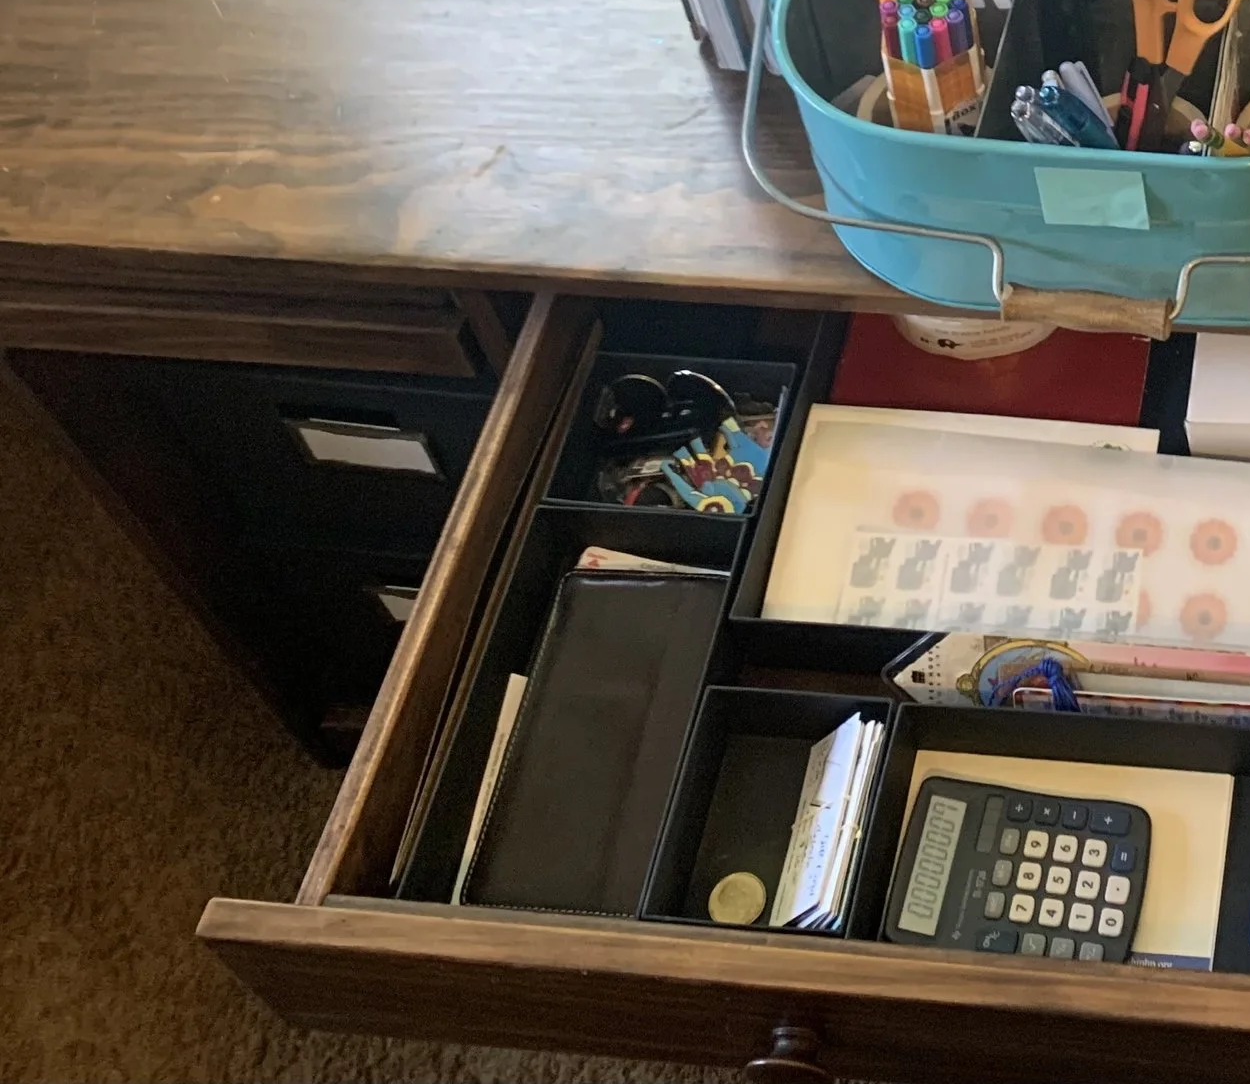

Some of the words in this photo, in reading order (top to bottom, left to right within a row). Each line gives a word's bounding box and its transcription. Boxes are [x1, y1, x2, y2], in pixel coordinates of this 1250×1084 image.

[1081, 880, 1094, 889] 2
[1088, 848, 1101, 858] 3
[1015, 903, 1028, 912] 7
[1022, 871, 1035, 881] 8
[1045, 908, 1057, 918] 4
[1052, 875, 1065, 885] 5
[1104, 917, 1118, 928] 0
